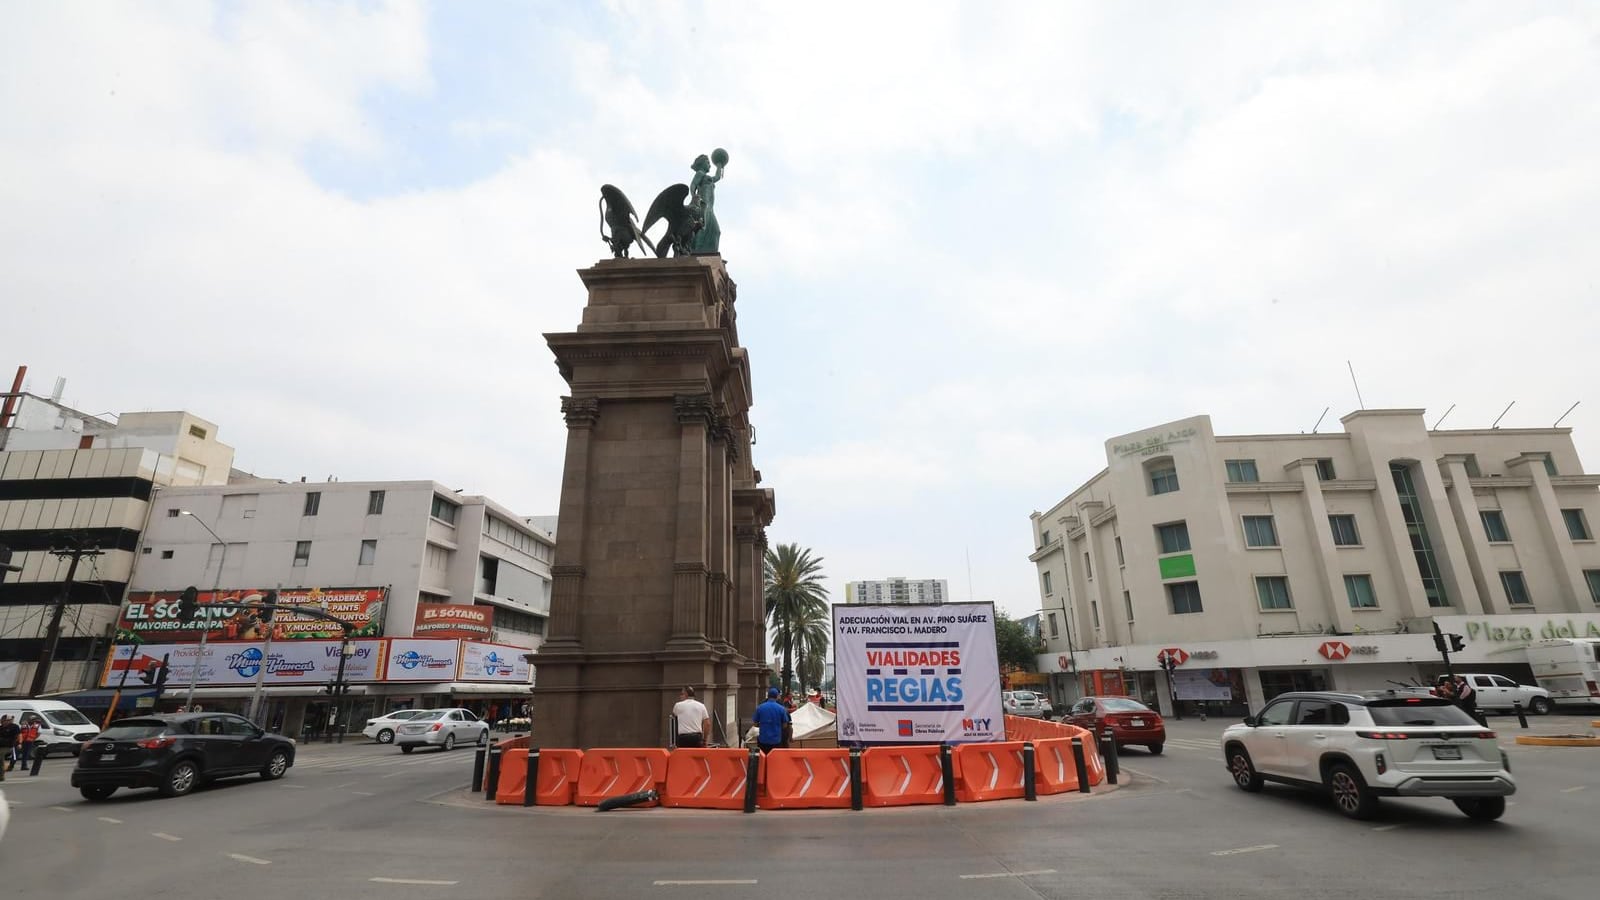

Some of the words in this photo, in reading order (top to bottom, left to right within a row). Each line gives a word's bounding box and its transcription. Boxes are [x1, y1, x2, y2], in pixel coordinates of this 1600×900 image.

[278, 595, 311, 603] WETERS
[126, 604, 149, 619] EL
[154, 600, 238, 619] SÓANO
[424, 609, 438, 618] EL
[439, 607, 484, 621] SÓTANO
[133, 621, 180, 630] MAYOREO
[839, 615, 890, 625] ADECUACIÓN
[911, 616, 921, 624] EN
[922, 616, 936, 624] AV.
[937, 616, 955, 624] PINO
[957, 614, 987, 623] SUÁREZ
[416, 623, 450, 631] MAYOREO
[458, 624, 488, 633] MENUDEO
[846, 626, 860, 634] AV.
[861, 626, 906, 634] FRANCISCO
[907, 626, 912, 634] I.
[914, 626, 947, 634] MADERO
[1466, 621, 1534, 641] Plaza
[1540, 619, 1577, 640] del
[866, 651, 961, 666] VIALIDADES
[866, 678, 963, 703] REGIAS
[962, 718, 991, 731] MTY
